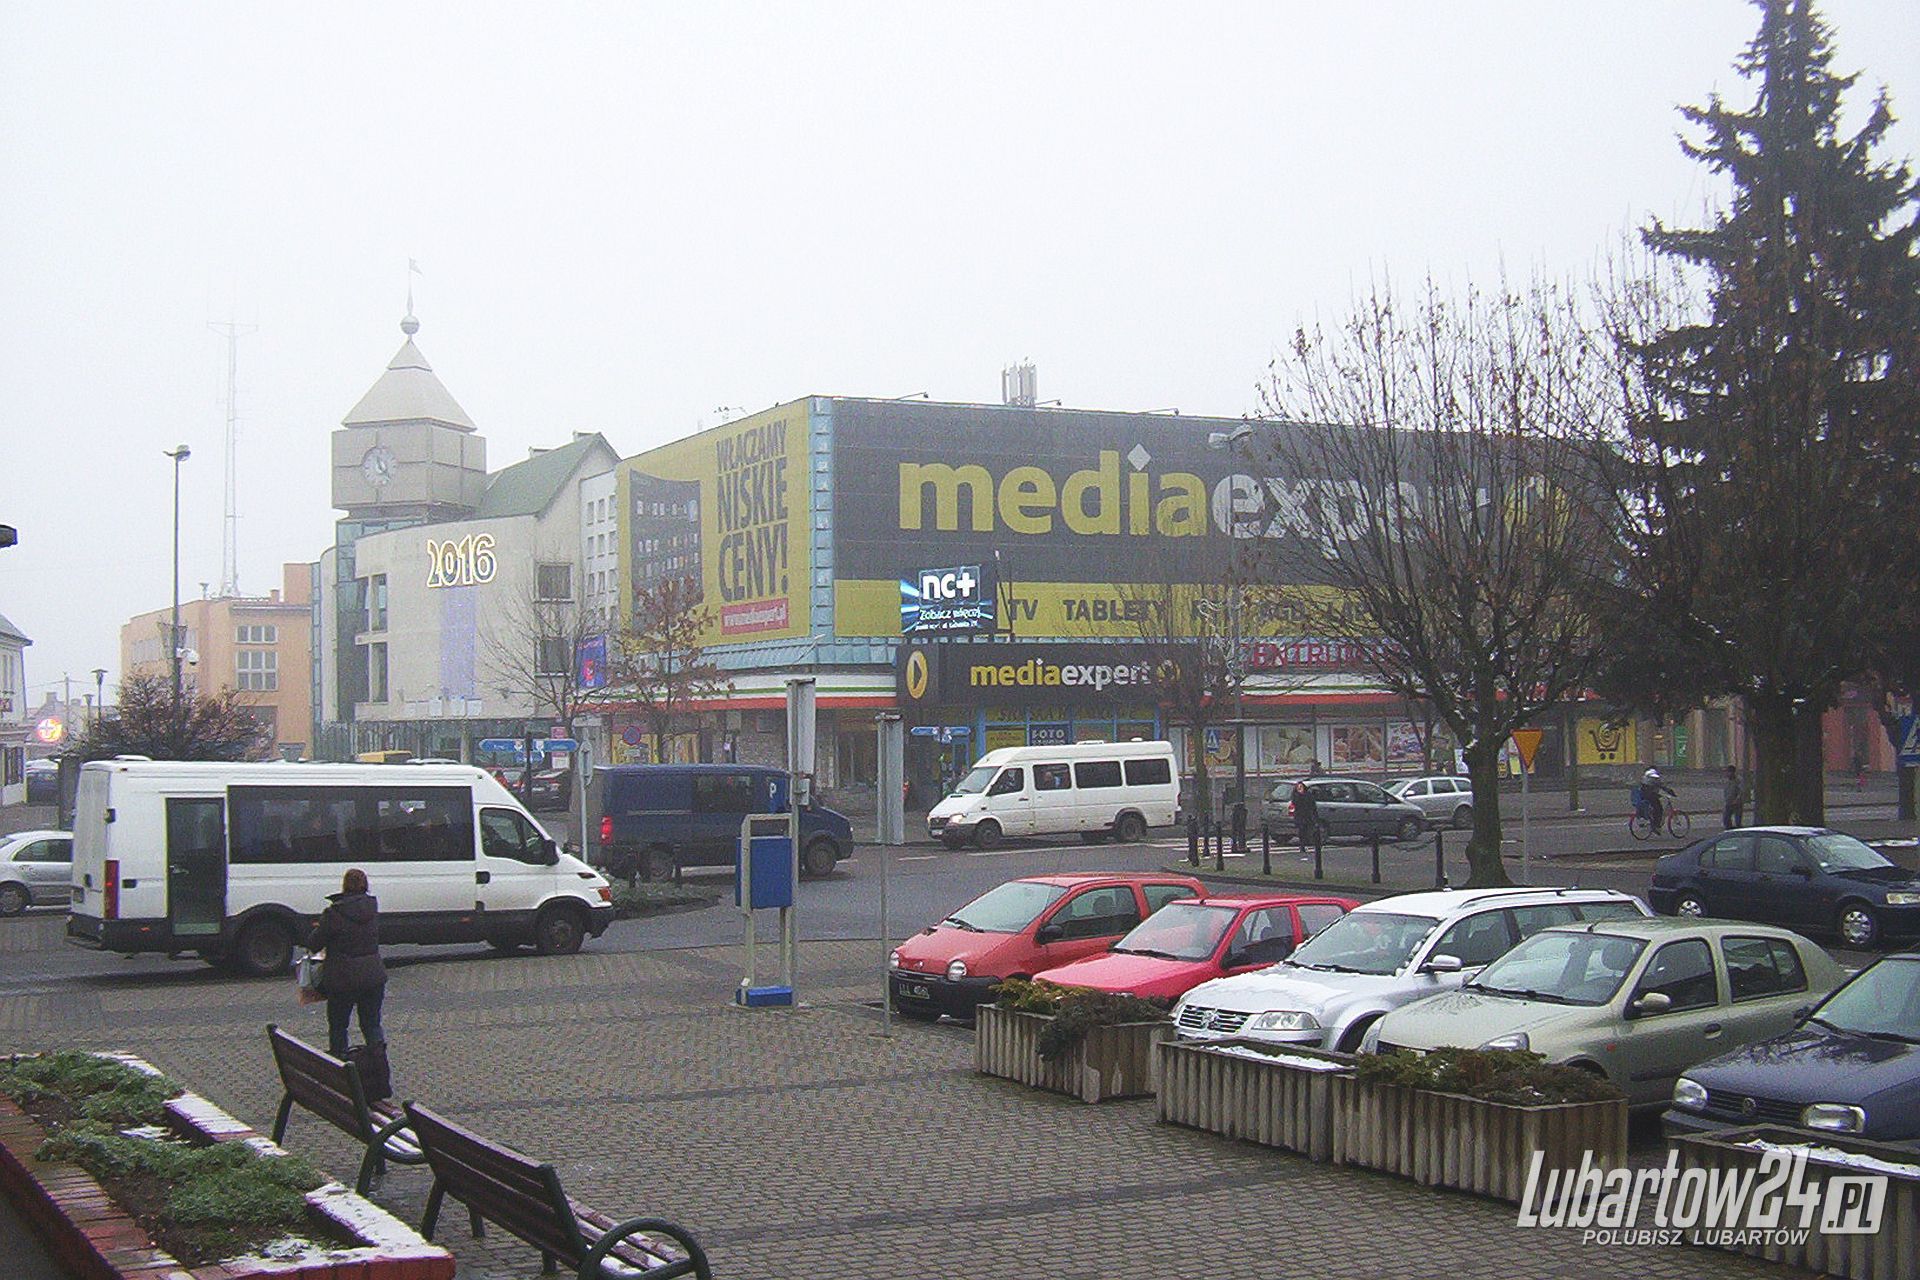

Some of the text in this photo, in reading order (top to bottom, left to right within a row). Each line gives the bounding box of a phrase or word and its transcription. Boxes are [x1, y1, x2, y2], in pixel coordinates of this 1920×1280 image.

[717, 457, 788, 534] NISKIE
[427, 533, 497, 588] 2016
[719, 522, 788, 602] CENY!
[922, 572, 976, 600] nc+
[1008, 599, 1038, 621] TV
[970, 658, 1150, 691] mediaexpert
